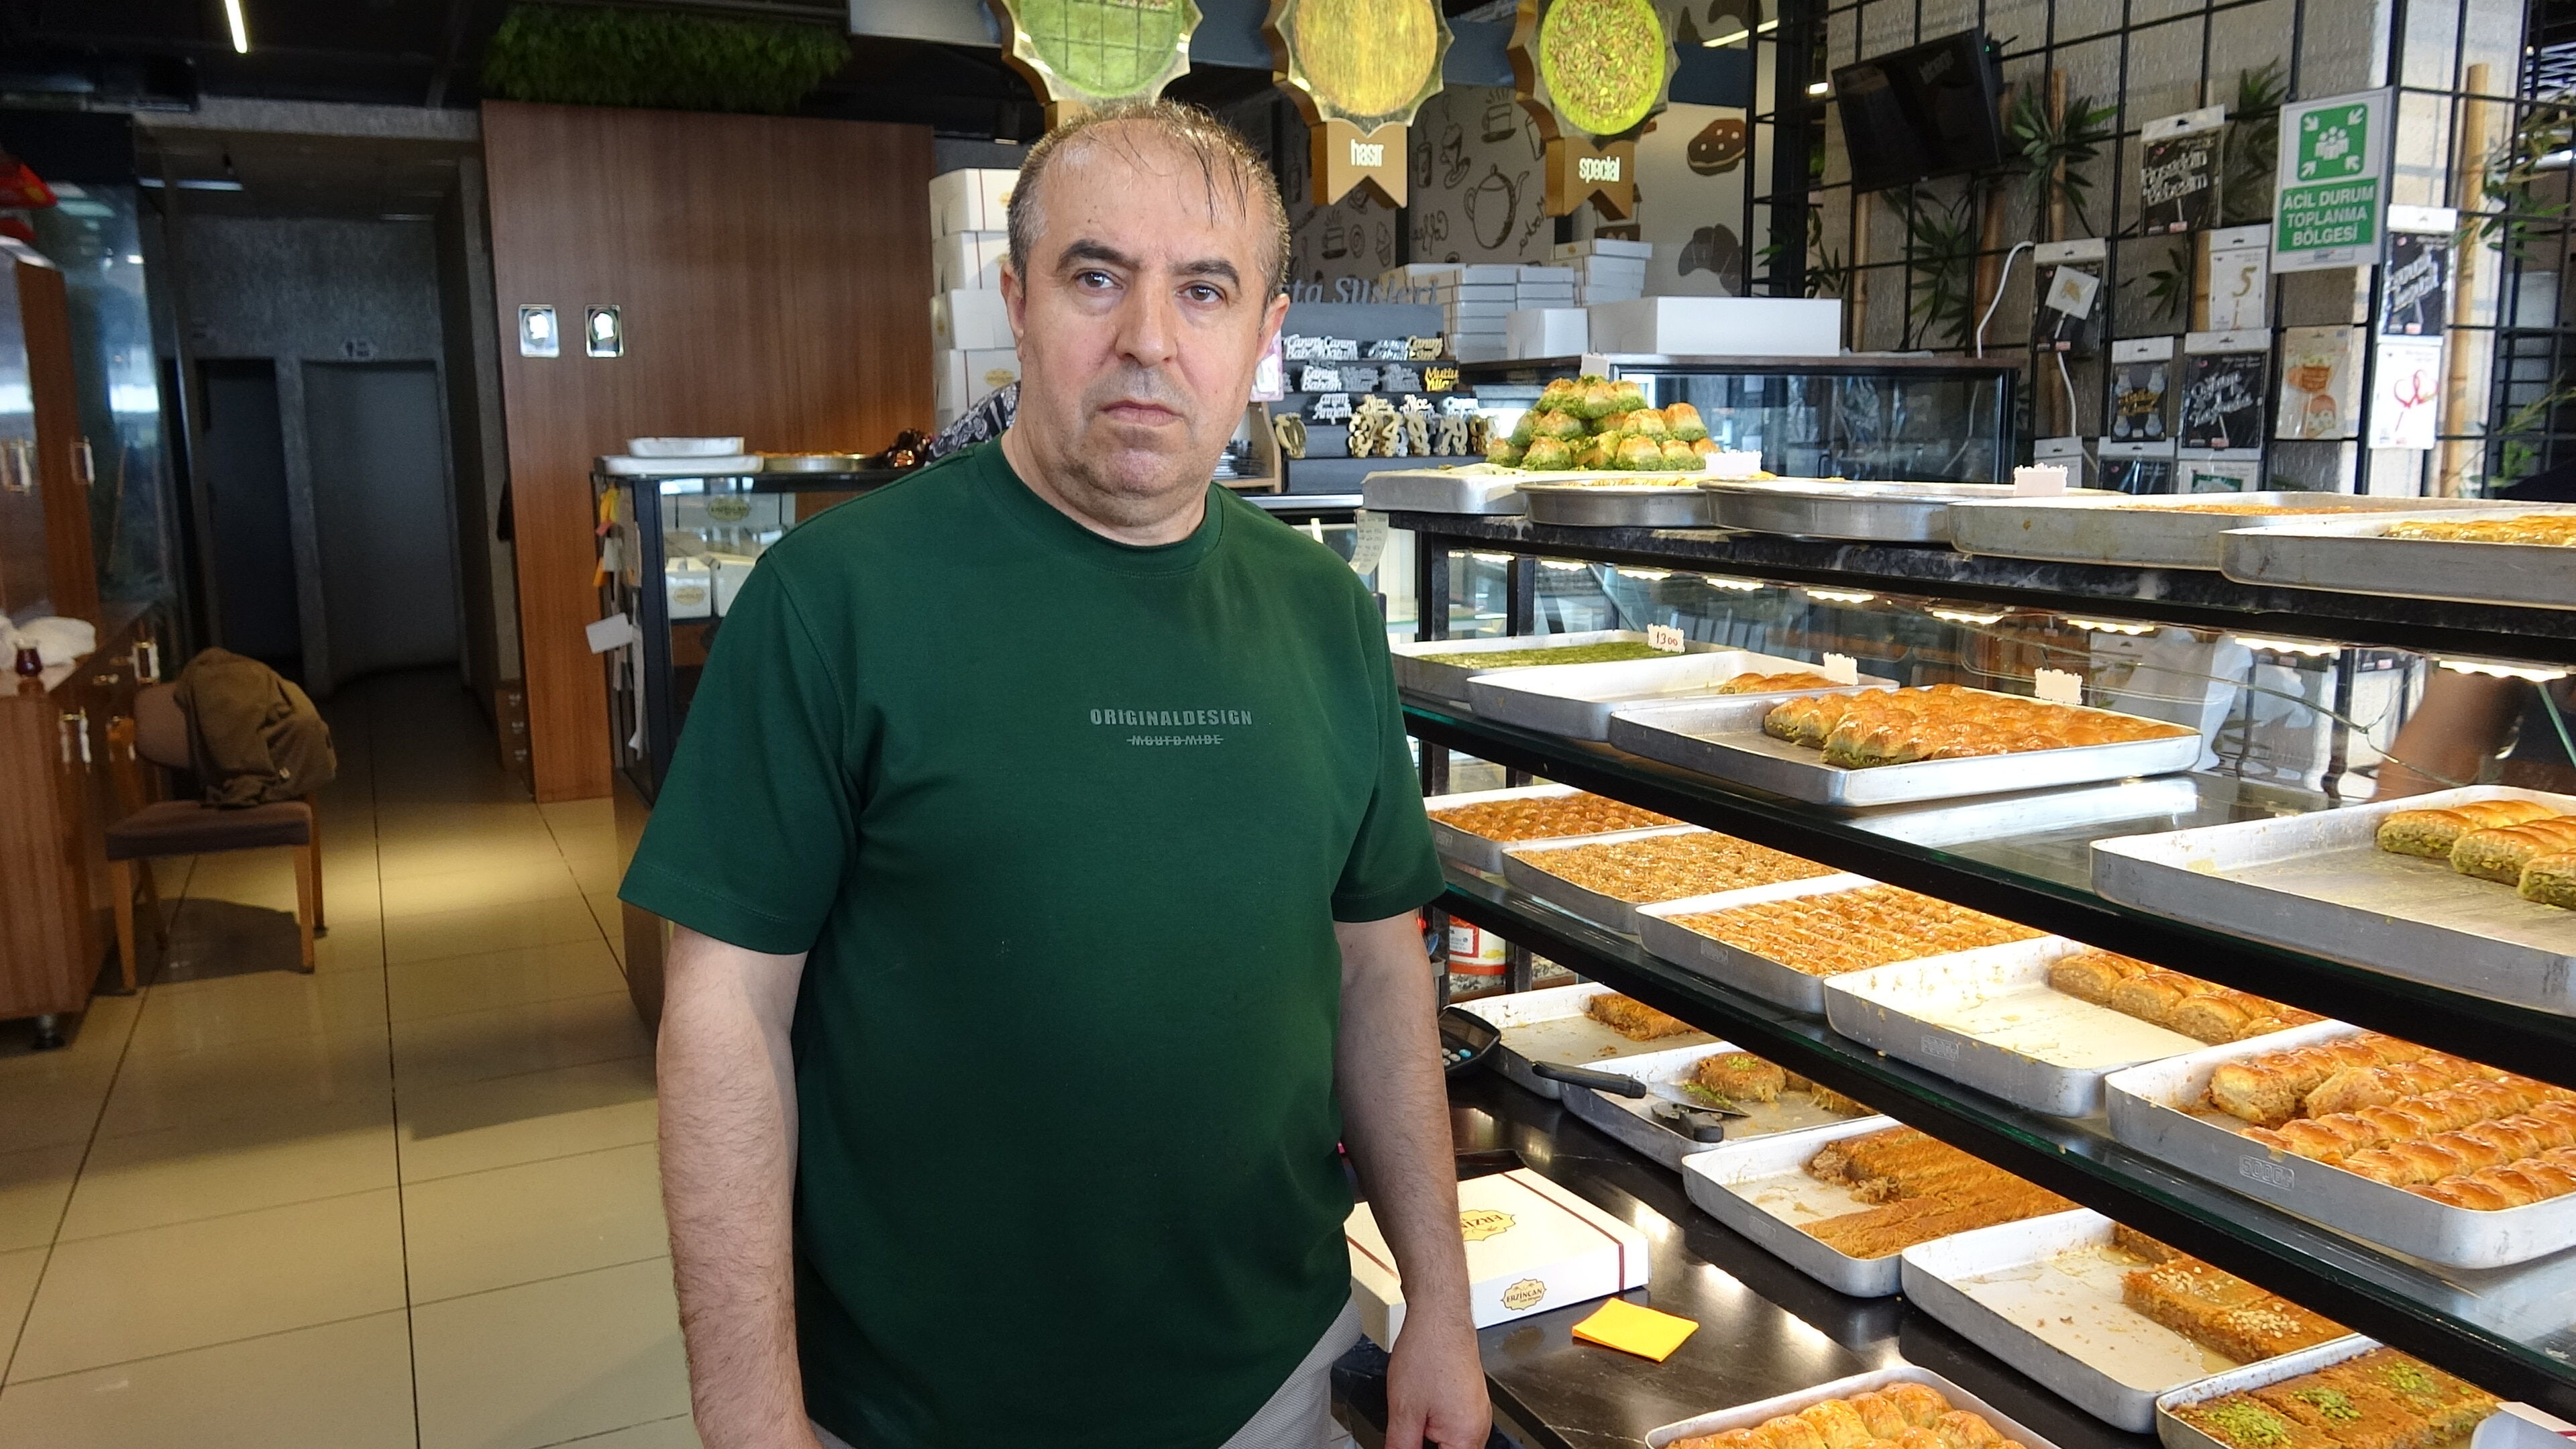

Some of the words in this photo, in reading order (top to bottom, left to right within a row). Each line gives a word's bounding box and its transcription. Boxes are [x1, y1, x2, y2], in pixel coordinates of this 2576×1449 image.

[1579, 156, 1620, 184] special
[2283, 190, 2316, 210] ACİL
[2319, 185, 2375, 207] DURUM
[2287, 205, 2367, 228] TOPLANMA
[2292, 222, 2359, 246] BÖLGESİ
[1656, 631, 1678, 646] 1300
[1090, 708, 1252, 725] ORIGINALDESIGN
